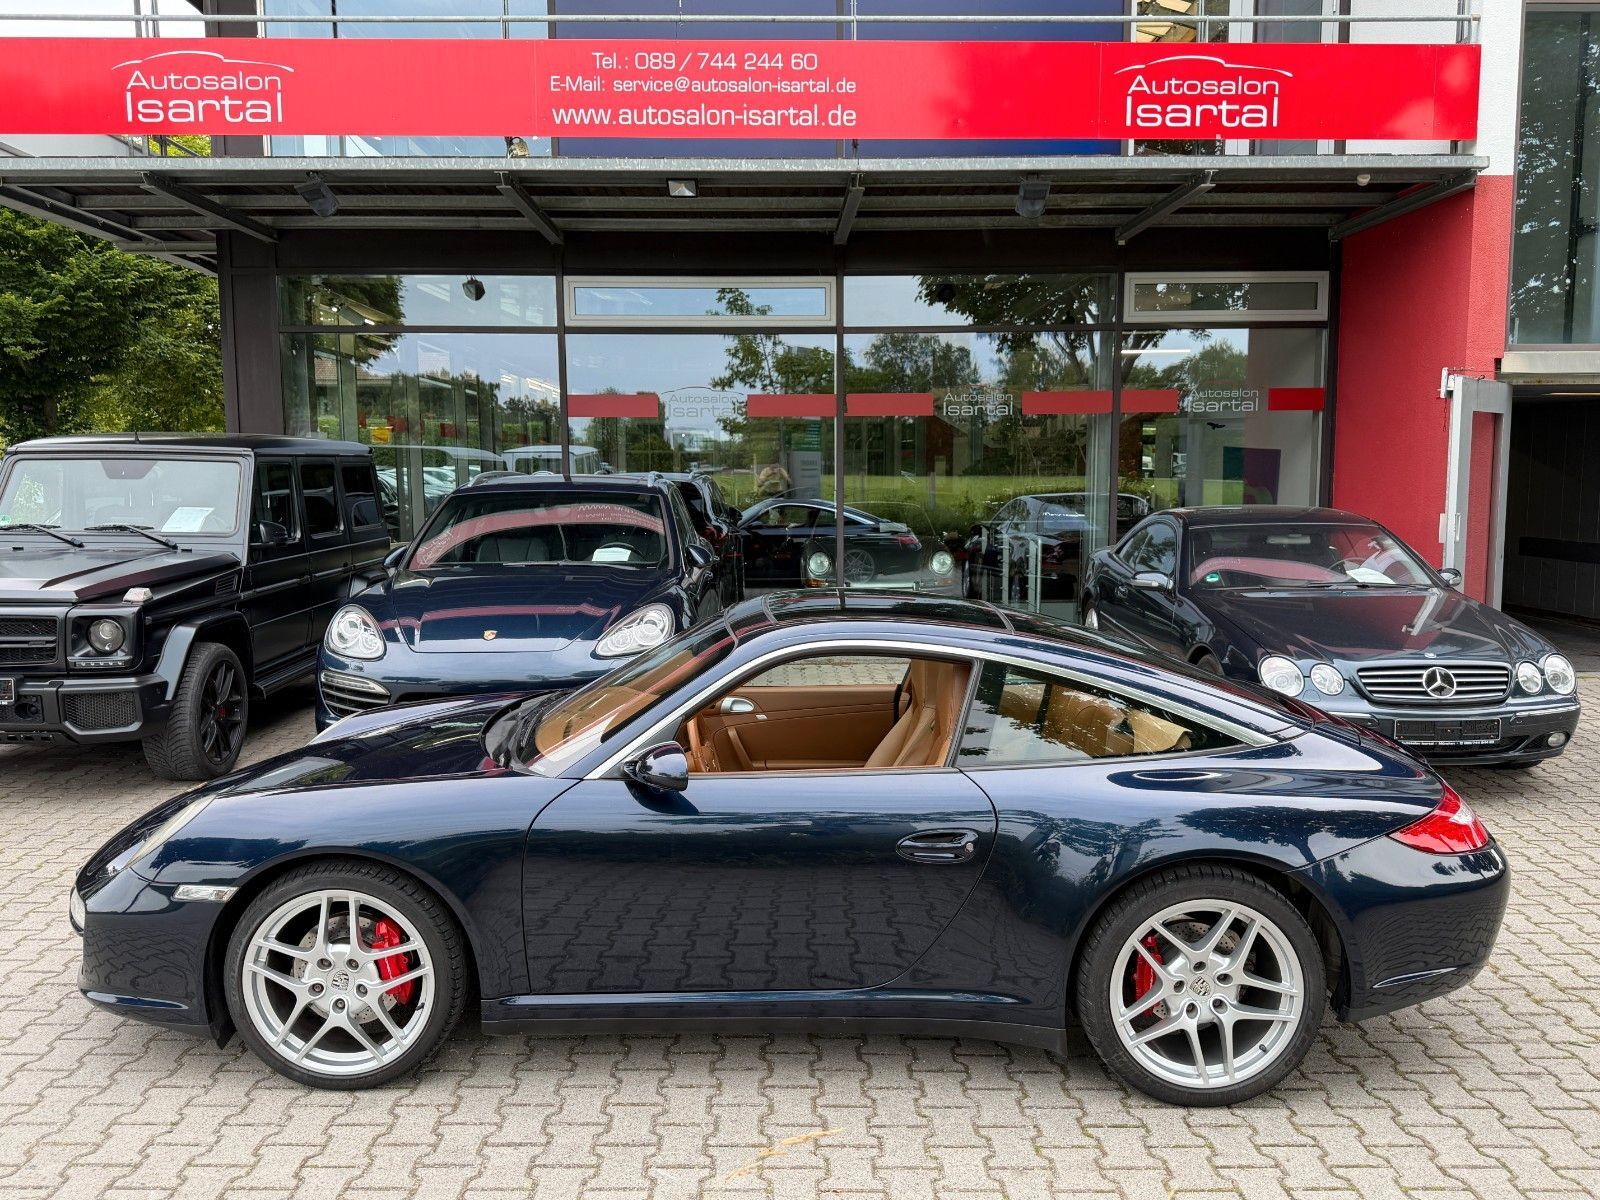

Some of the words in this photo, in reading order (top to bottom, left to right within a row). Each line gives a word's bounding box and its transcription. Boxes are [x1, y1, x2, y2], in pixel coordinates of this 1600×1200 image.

[593, 52, 628, 70] Tel.:
[744, 52, 784, 70] 244
[790, 52, 818, 70] 60
[126, 71, 281, 90] Autosalon
[550, 75, 605, 92] E-Mail:
[612, 77, 857, 93] service@autosalon-isartal.de
[1128, 75, 1279, 95] Autosalon
[126, 92, 282, 122] Isartal
[552, 103, 857, 126] www.autosalon-isartal.de
[1126, 96, 1278, 127] Isartal
[669, 394, 738, 404] Autosalon
[944, 392, 1013, 402] Autosalon
[1189, 388, 1259, 398] Autosalon
[943, 401, 1013, 416] Isartal
[1188, 397, 1259, 412] Isartal
